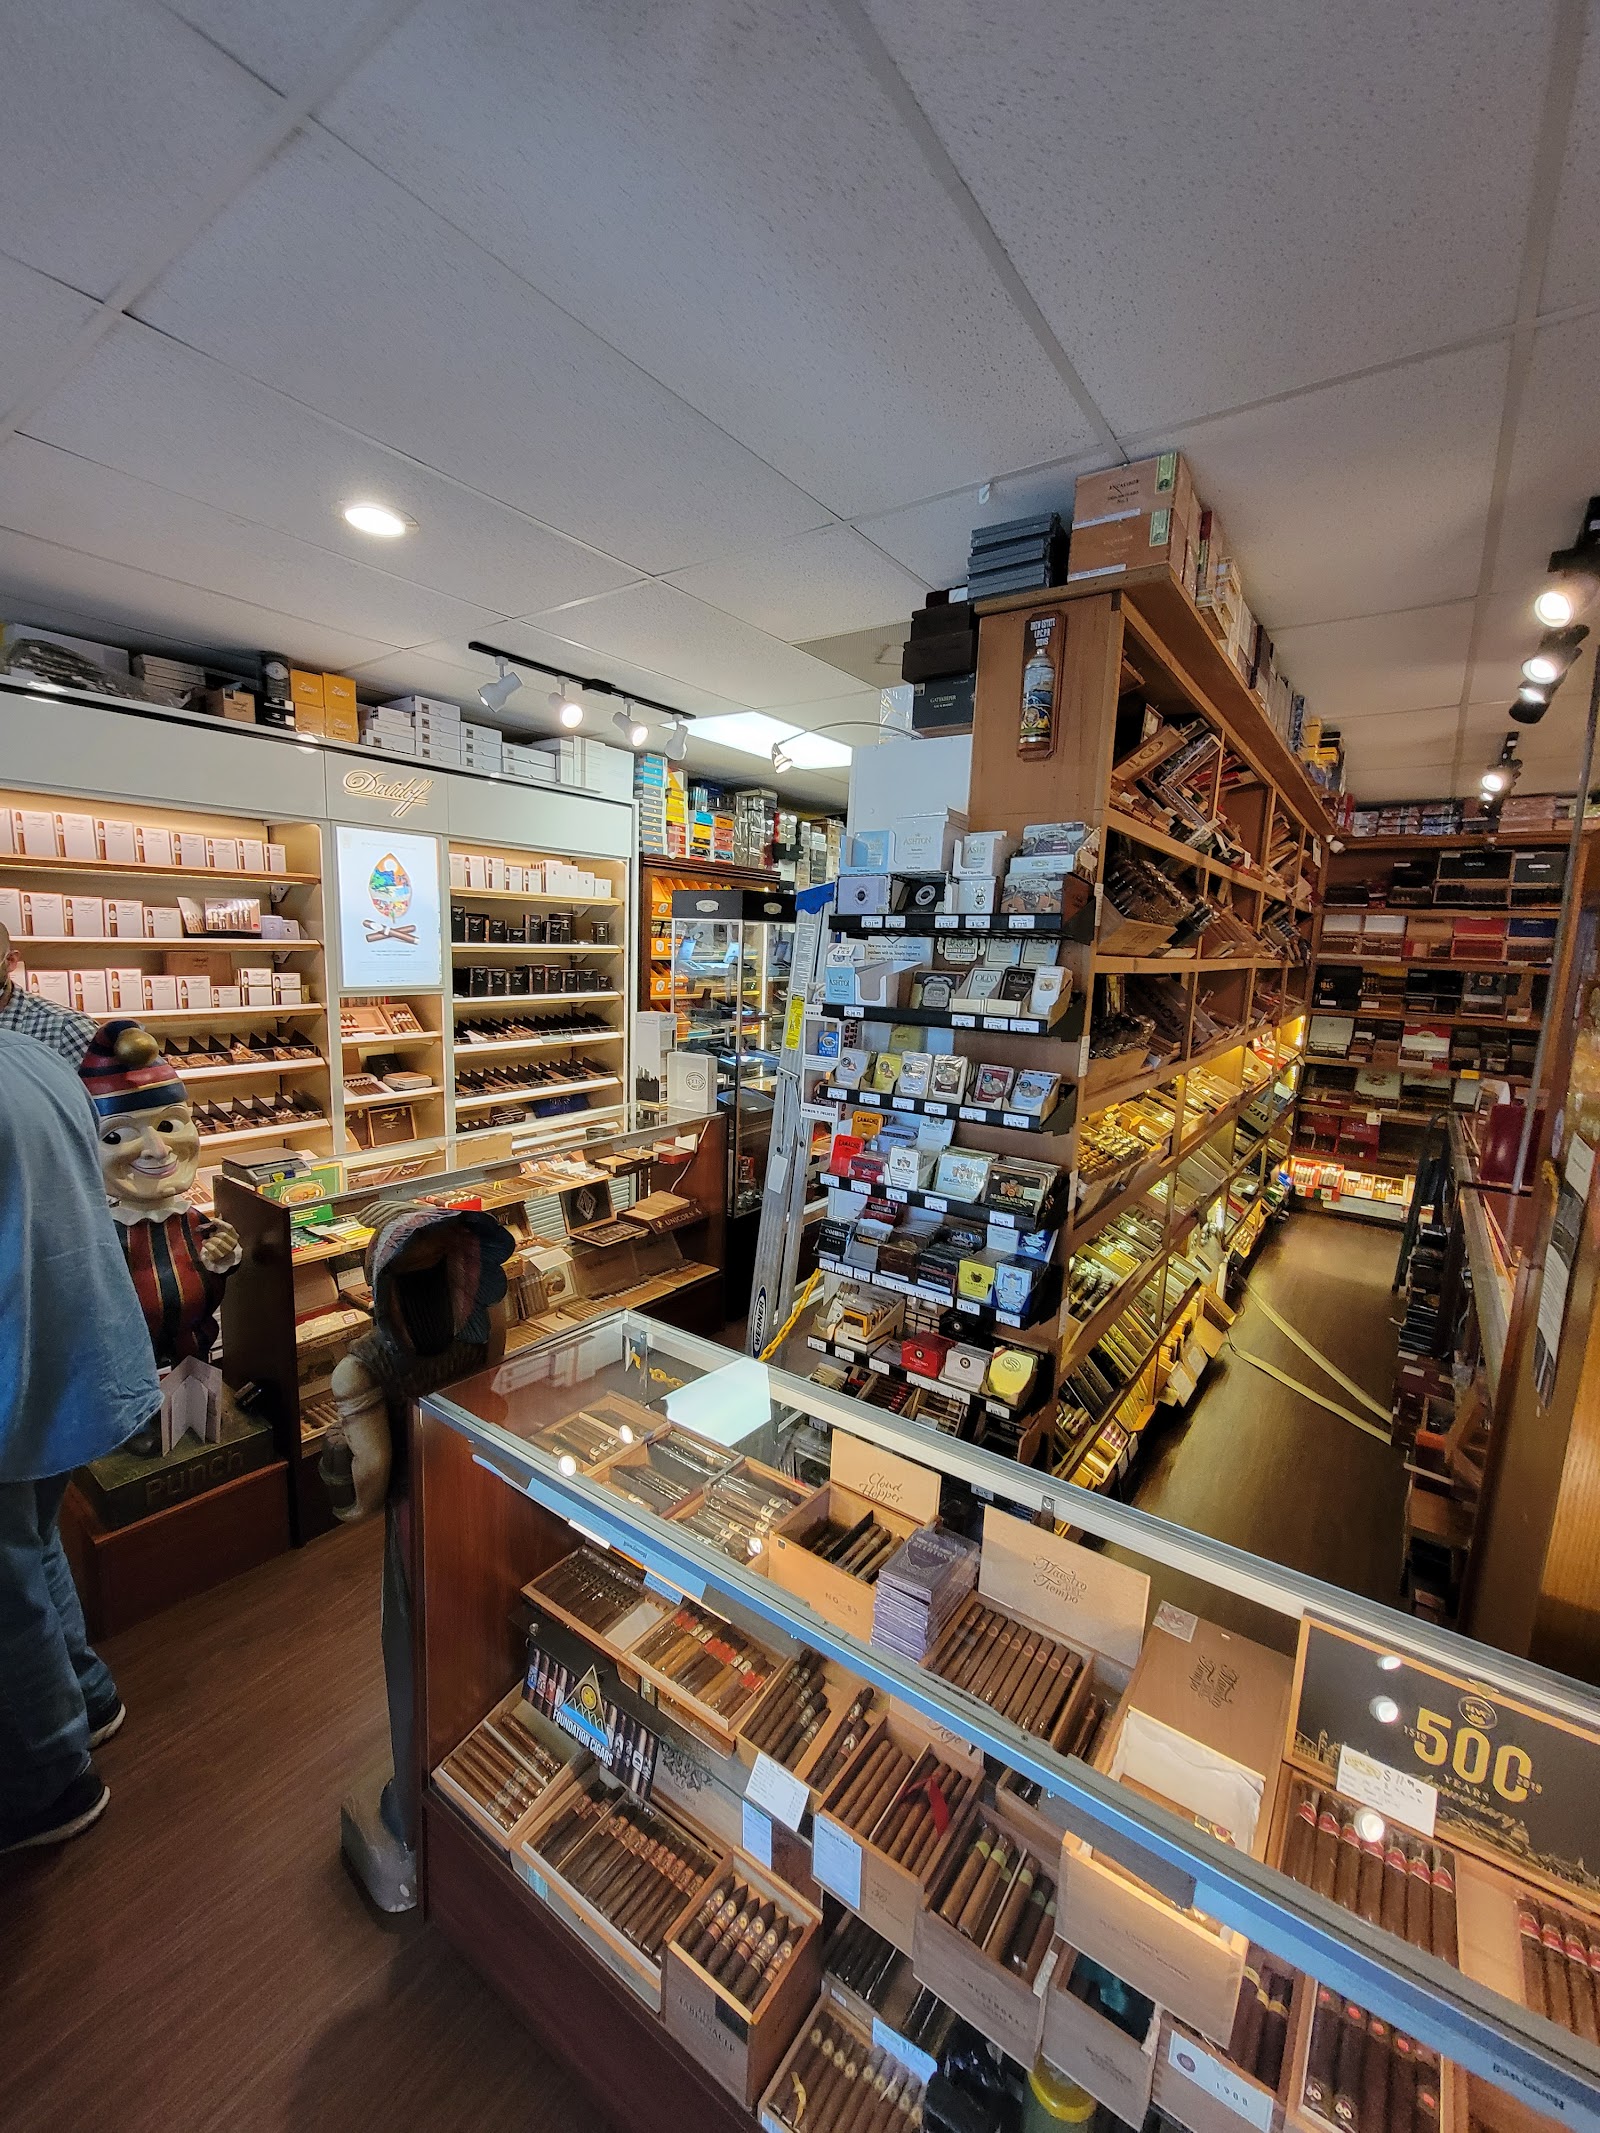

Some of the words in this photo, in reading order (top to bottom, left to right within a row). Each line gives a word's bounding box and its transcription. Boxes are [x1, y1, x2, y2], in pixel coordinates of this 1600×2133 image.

[343, 769, 435, 818] Davidoff
[903, 836, 932, 846] ASHTON
[974, 972, 998, 982] OLIVA
[856, 1115, 879, 1125] CAMACHO
[942, 1176, 979, 1189] MACANUDO
[990, 1193, 1033, 1207] MACANUDO
[664, 1211, 695, 1226] UNICORN
[754, 1300, 765, 1346] WERNER
[868, 1472, 903, 1492] Cloud
[858, 1482, 904, 1504] Hopper
[1032, 1555, 1088, 1591] Maestro
[1033, 1573, 1079, 1604] Tiempo
[552, 1708, 591, 1749] FOUNDATION
[588, 1737, 615, 1767] CIGARS
[1403, 1725, 1428, 1743] 1519
[1413, 1707, 1533, 1803] 500
[1443, 1773, 1491, 1802] YEARS
[1516, 1776, 1544, 1795] 2019
